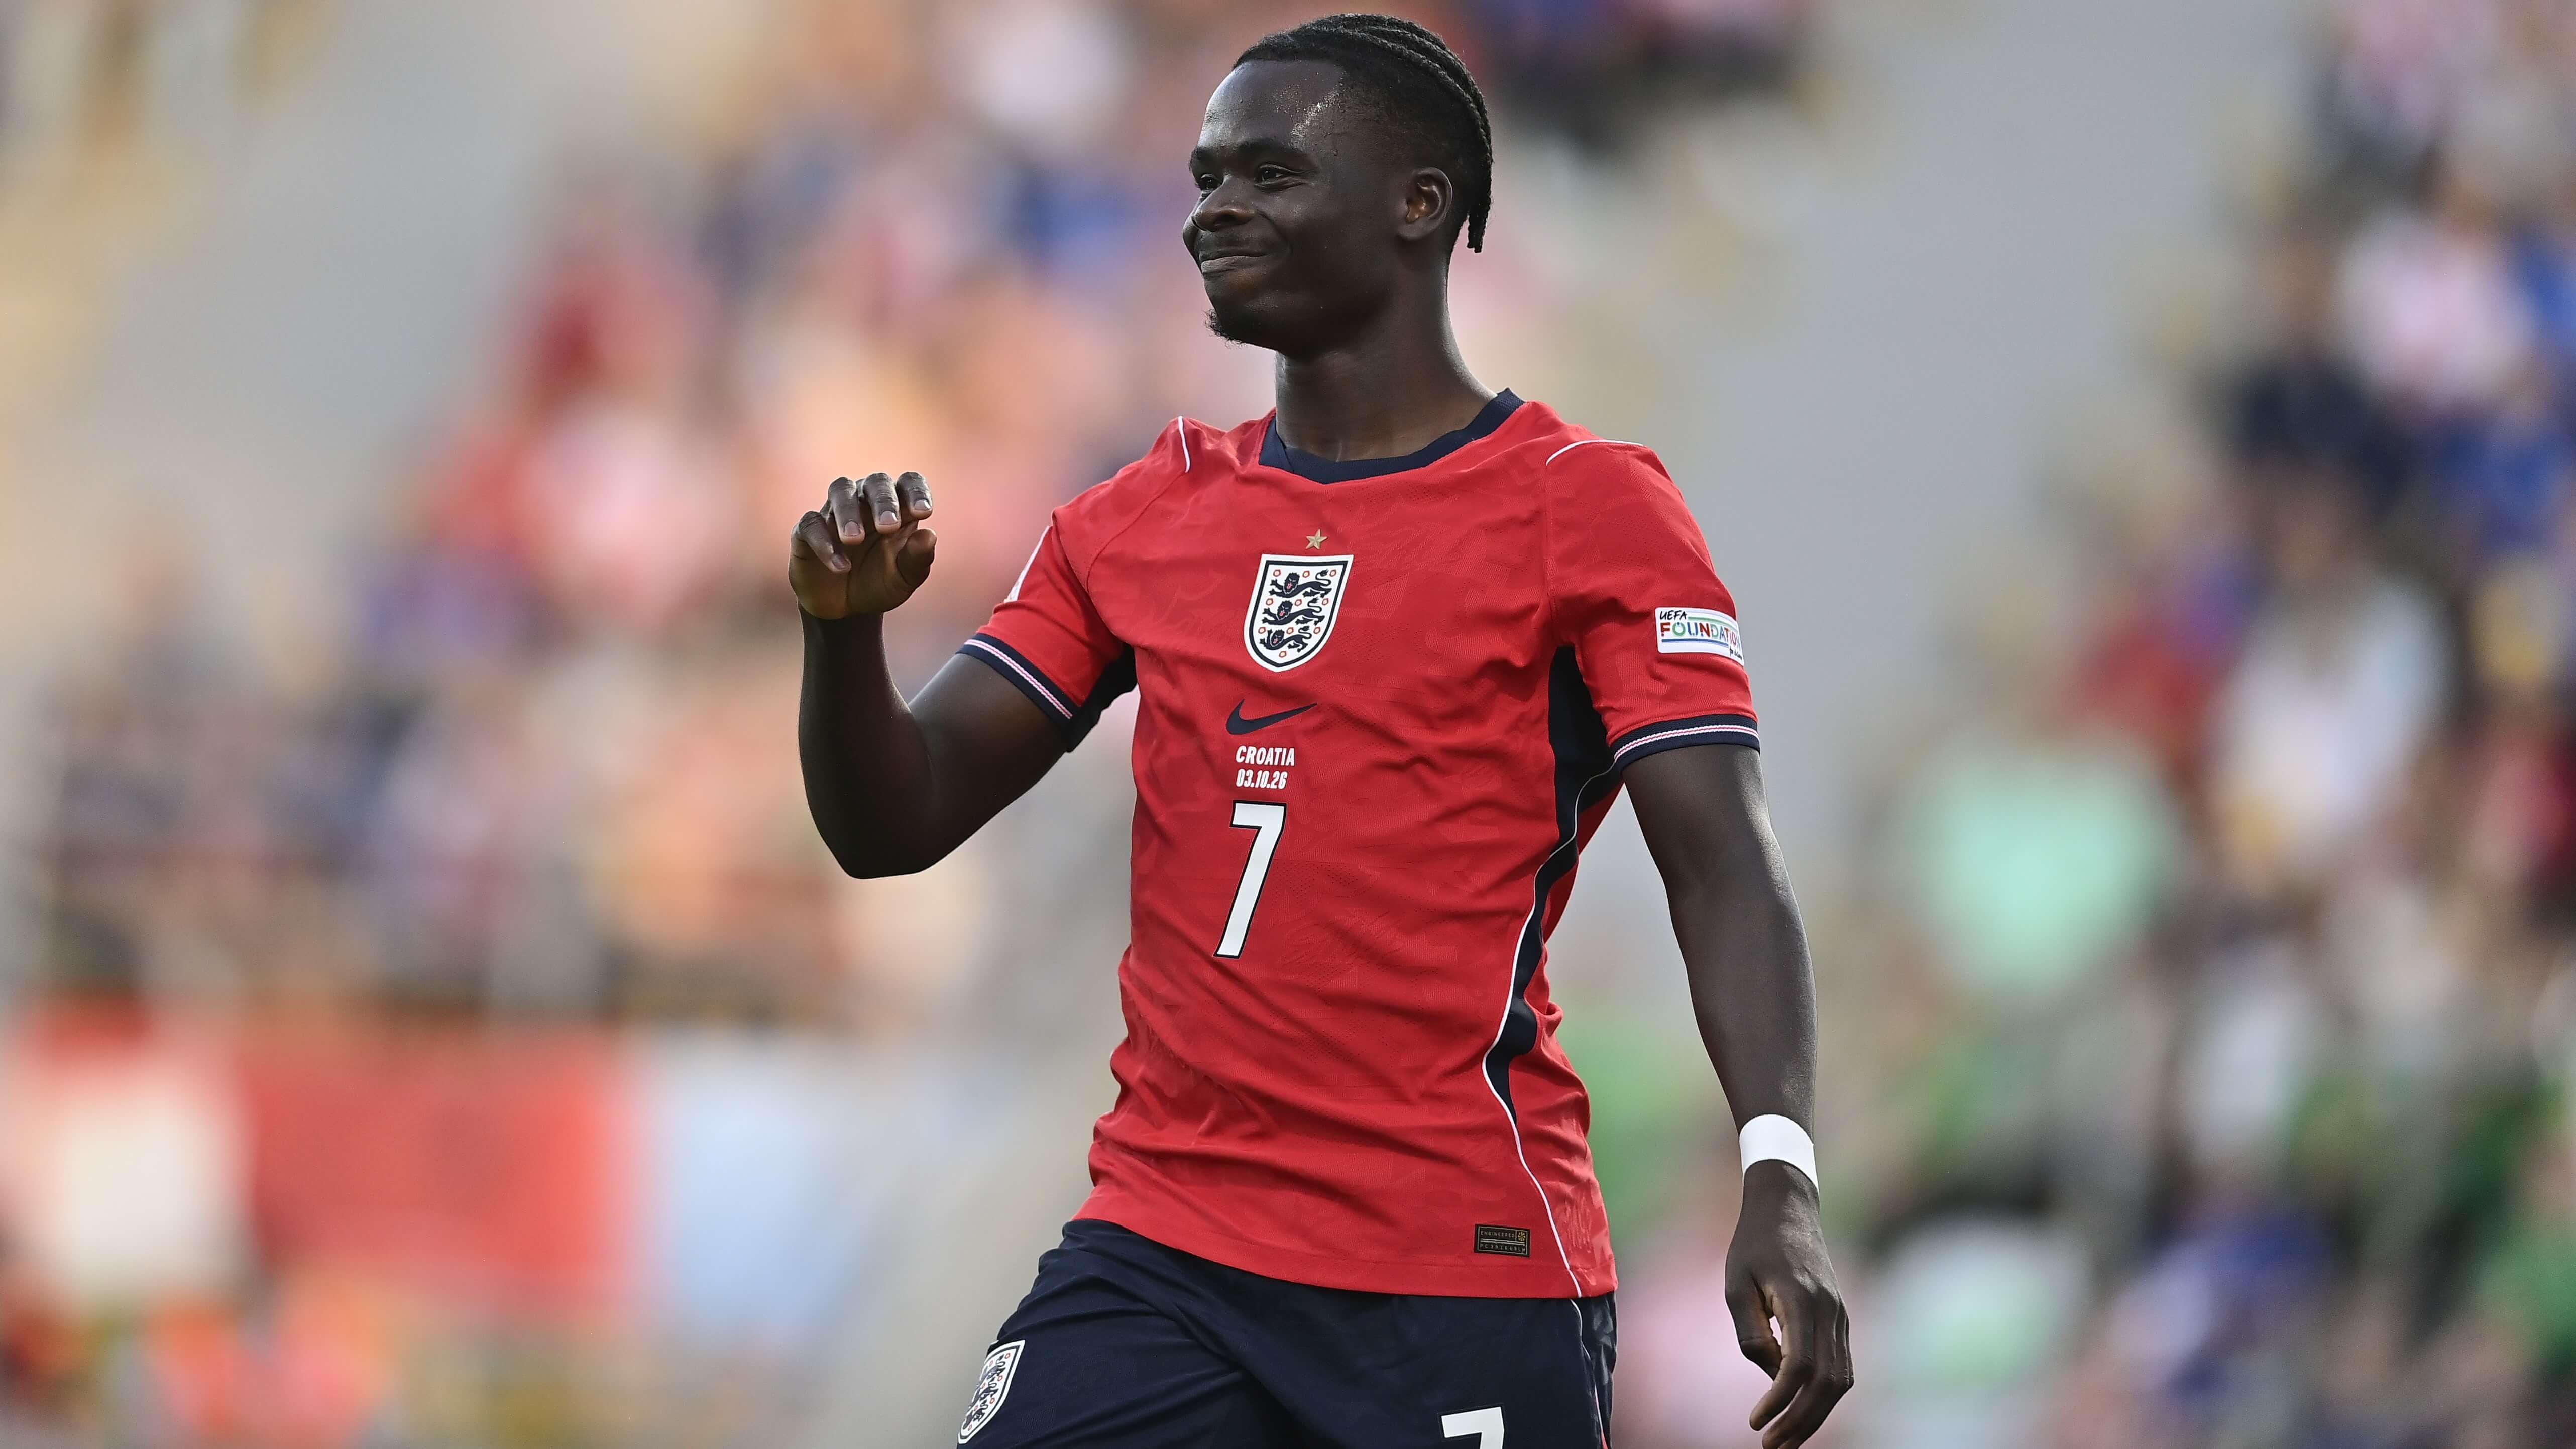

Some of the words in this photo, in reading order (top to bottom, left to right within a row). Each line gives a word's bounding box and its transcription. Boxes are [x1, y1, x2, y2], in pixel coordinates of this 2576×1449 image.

[1659, 610, 1687, 620] UEFA
[1236, 745, 1295, 766] CROATIA
[1236, 769, 1288, 789] 03.10.26
[1213, 800, 1287, 959] 7
